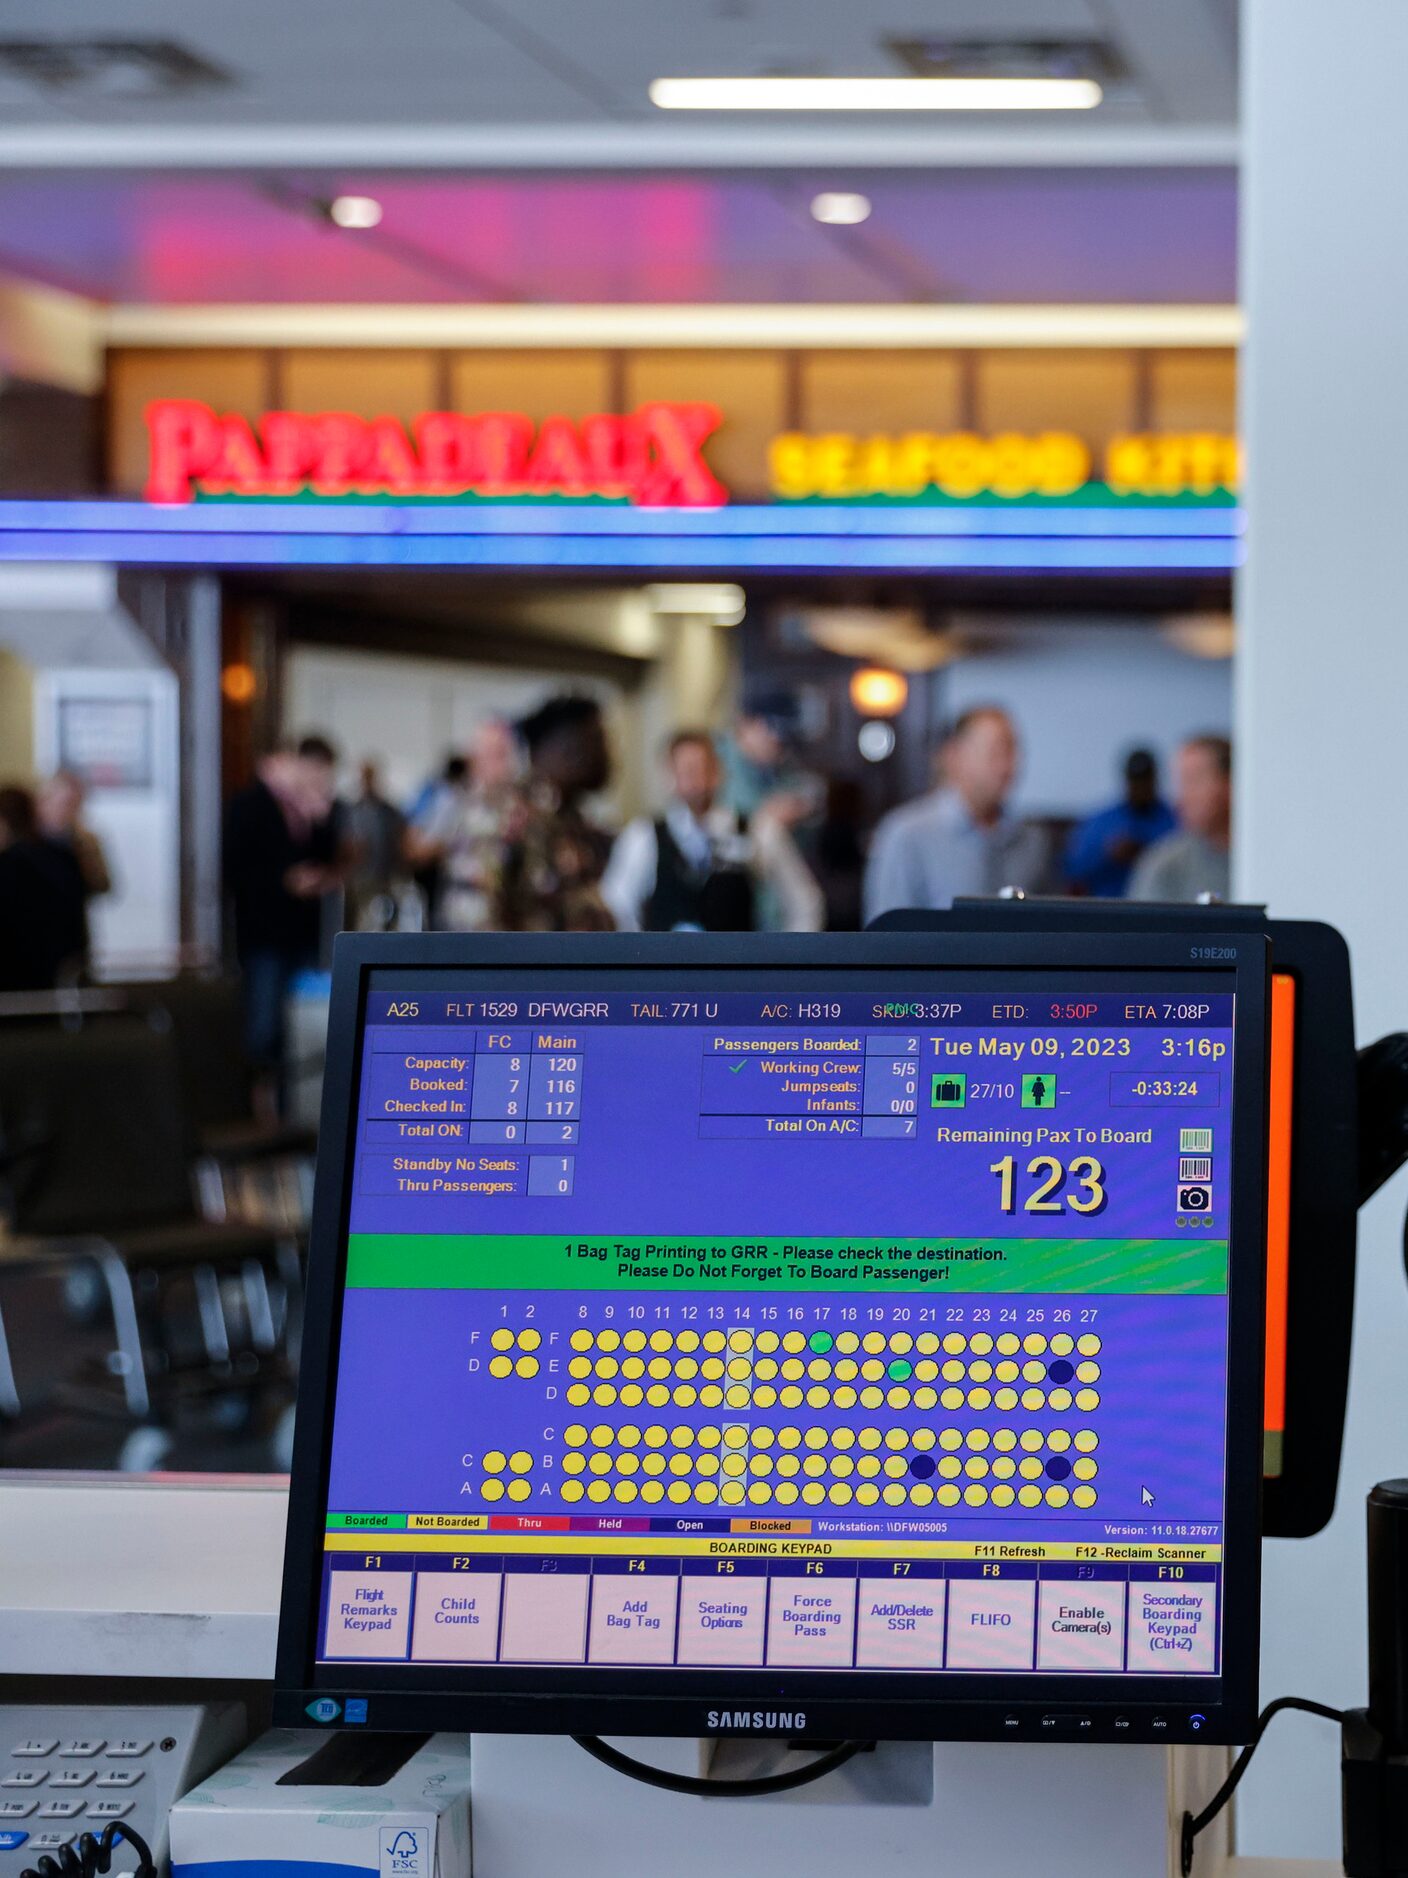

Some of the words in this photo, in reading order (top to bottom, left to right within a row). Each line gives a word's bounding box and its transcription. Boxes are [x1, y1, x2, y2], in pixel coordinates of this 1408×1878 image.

[769, 431, 1091, 499] SEAFOOD
[1190, 947, 1236, 959] S19E200
[387, 1003, 419, 1017] A25
[447, 1003, 475, 1017] FLT
[480, 1003, 518, 1017] 1529
[528, 1003, 609, 1017] DFWGRR
[630, 1004, 668, 1018] TAIL:
[671, 1003, 698, 1017] 771
[706, 1003, 718, 1017] U
[761, 1004, 792, 1018] A/C:
[799, 1004, 841, 1018] H319
[915, 1004, 961, 1018] 3:37P
[992, 1005, 1029, 1019] ETD:
[1050, 1005, 1098, 1019] 3:50P
[1125, 1006, 1156, 1019] ETA
[1163, 1005, 1210, 1019] 7:08P
[488, 1036, 511, 1049] FC
[538, 1036, 577, 1049] Main
[714, 1038, 798, 1053] Passengers
[804, 1039, 861, 1050] Boarded:
[908, 1039, 917, 1051] 2
[930, 1038, 973, 1056] Tue
[979, 1038, 1025, 1061] May
[1031, 1038, 1065, 1059] 09,
[1071, 1038, 1130, 1056] 2023
[1162, 1038, 1226, 1061] 3:16p
[405, 1057, 469, 1070] Capacity:
[510, 1058, 520, 1071] 8
[549, 1058, 576, 1072] 120
[761, 1061, 819, 1076] Working
[823, 1062, 861, 1074] Crew:
[892, 1063, 916, 1077] 5/5
[410, 1078, 468, 1091] Booked:
[510, 1080, 519, 1093] 7
[547, 1080, 575, 1093] 116
[781, 1080, 861, 1095] Jumpseats:
[906, 1081, 915, 1093] 0
[970, 1083, 1015, 1099] 27/10
[1132, 1081, 1198, 1095] -0:33:24
[384, 1100, 447, 1112] Checked
[450, 1101, 466, 1113] In:
[507, 1101, 517, 1115] 8
[545, 1101, 574, 1115] 117
[807, 1099, 860, 1111] Infants:
[891, 1100, 914, 1114] 0/0
[398, 1123, 434, 1136] Total
[438, 1124, 463, 1137] ON:
[506, 1125, 516, 1139] 0
[562, 1126, 572, 1139] 2
[766, 1119, 802, 1132] Total
[806, 1120, 826, 1132] On
[829, 1120, 859, 1133] A/C:
[904, 1121, 913, 1133] 7
[937, 1128, 1033, 1147] Remaining
[1037, 1128, 1070, 1143] Pax
[1075, 1128, 1097, 1143] To
[1100, 1129, 1152, 1143] Board
[393, 1158, 452, 1173] Standby
[456, 1158, 475, 1171] No
[479, 1159, 519, 1171] Seats:
[562, 1159, 567, 1171] 1
[397, 1179, 429, 1192] Thru
[432, 1179, 517, 1194] Passengers:
[559, 1179, 567, 1192] 0
[989, 1155, 1108, 1216] 123
[564, 1244, 572, 1257] 1
[577, 1244, 607, 1262] Bag
[614, 1245, 640, 1261] Tag
[646, 1245, 707, 1262] Printing
[711, 1246, 726, 1258] to
[731, 1245, 768, 1258] GRR
[783, 1246, 833, 1259] Please
[838, 1246, 883, 1259] check
[888, 1247, 912, 1260] the
[917, 1247, 1007, 1260] destination.
[618, 1264, 668, 1277] Please
[673, 1264, 695, 1277] Do
[699, 1265, 726, 1278] Not
[731, 1265, 782, 1281] Forget
[787, 1265, 806, 1278] To
[811, 1265, 858, 1278] Board
[863, 1265, 949, 1282] Passenger!
[708, 1307, 724, 1320] 13
[734, 1308, 750, 1320] 14
[761, 1308, 778, 1320] 15
[787, 1308, 804, 1320] 16
[814, 1308, 831, 1320] 17
[841, 1308, 857, 1320] 18
[867, 1308, 884, 1320] 19
[893, 1308, 910, 1320] 20
[920, 1308, 936, 1321] 21
[947, 1309, 964, 1321] 22
[973, 1309, 990, 1321] 23
[1000, 1309, 1017, 1322] 24
[1026, 1309, 1045, 1322] 25
[1053, 1309, 1071, 1322] 26
[1081, 1310, 1098, 1322] 27
[345, 1517, 387, 1526] Boarded
[415, 1517, 434, 1526] Not
[438, 1518, 480, 1526] Boarded
[517, 1518, 542, 1527] Thru
[599, 1520, 622, 1528] Held
[677, 1521, 704, 1531] Open
[750, 1521, 791, 1530] Blocked
[818, 1522, 884, 1532] Workstation:
[887, 1523, 947, 1533] \\DFW05005
[1104, 1525, 1148, 1535] Version:
[1151, 1526, 1218, 1536] 11.0.18.27677
[710, 1543, 777, 1553] BOARDING
[782, 1543, 832, 1554] KEYPAD
[974, 1546, 995, 1556] F11
[1000, 1546, 1045, 1557] Refresh
[1076, 1547, 1097, 1557] F12
[1158, 1548, 1206, 1559] Scanner
[365, 1556, 381, 1568] F1
[453, 1558, 470, 1569] F2
[629, 1561, 645, 1572] F4
[717, 1561, 735, 1573] F5
[806, 1563, 823, 1574] F6
[894, 1564, 911, 1575] F7
[983, 1565, 1000, 1576] F8
[1158, 1567, 1184, 1578] F10
[355, 1589, 384, 1602] Flight
[794, 1595, 831, 1606] Force
[1143, 1594, 1202, 1608] Secondary
[341, 1604, 398, 1615] Remarks
[441, 1599, 475, 1610] Child
[623, 1602, 647, 1612] Add
[699, 1602, 747, 1616] Seating
[871, 1604, 933, 1617] Add/Delete
[435, 1613, 479, 1624] Counts
[783, 1610, 841, 1624] Boarding
[1059, 1607, 1104, 1618] Enable
[1143, 1609, 1202, 1622] Boarding
[344, 1619, 392, 1631] Keypad
[607, 1615, 630, 1628] Bag
[636, 1616, 660, 1629] Tag
[701, 1616, 743, 1629] Options
[888, 1619, 915, 1630] SSR
[971, 1614, 1011, 1625] FLIFO
[794, 1625, 826, 1636] Pass
[1052, 1622, 1111, 1635] Camera(s)
[1148, 1623, 1197, 1636] Keypad
[1150, 1638, 1192, 1651] (Ctrl+Z)
[708, 1711, 806, 1728] SAMSUNG
[392, 1860, 418, 1868] FSC
